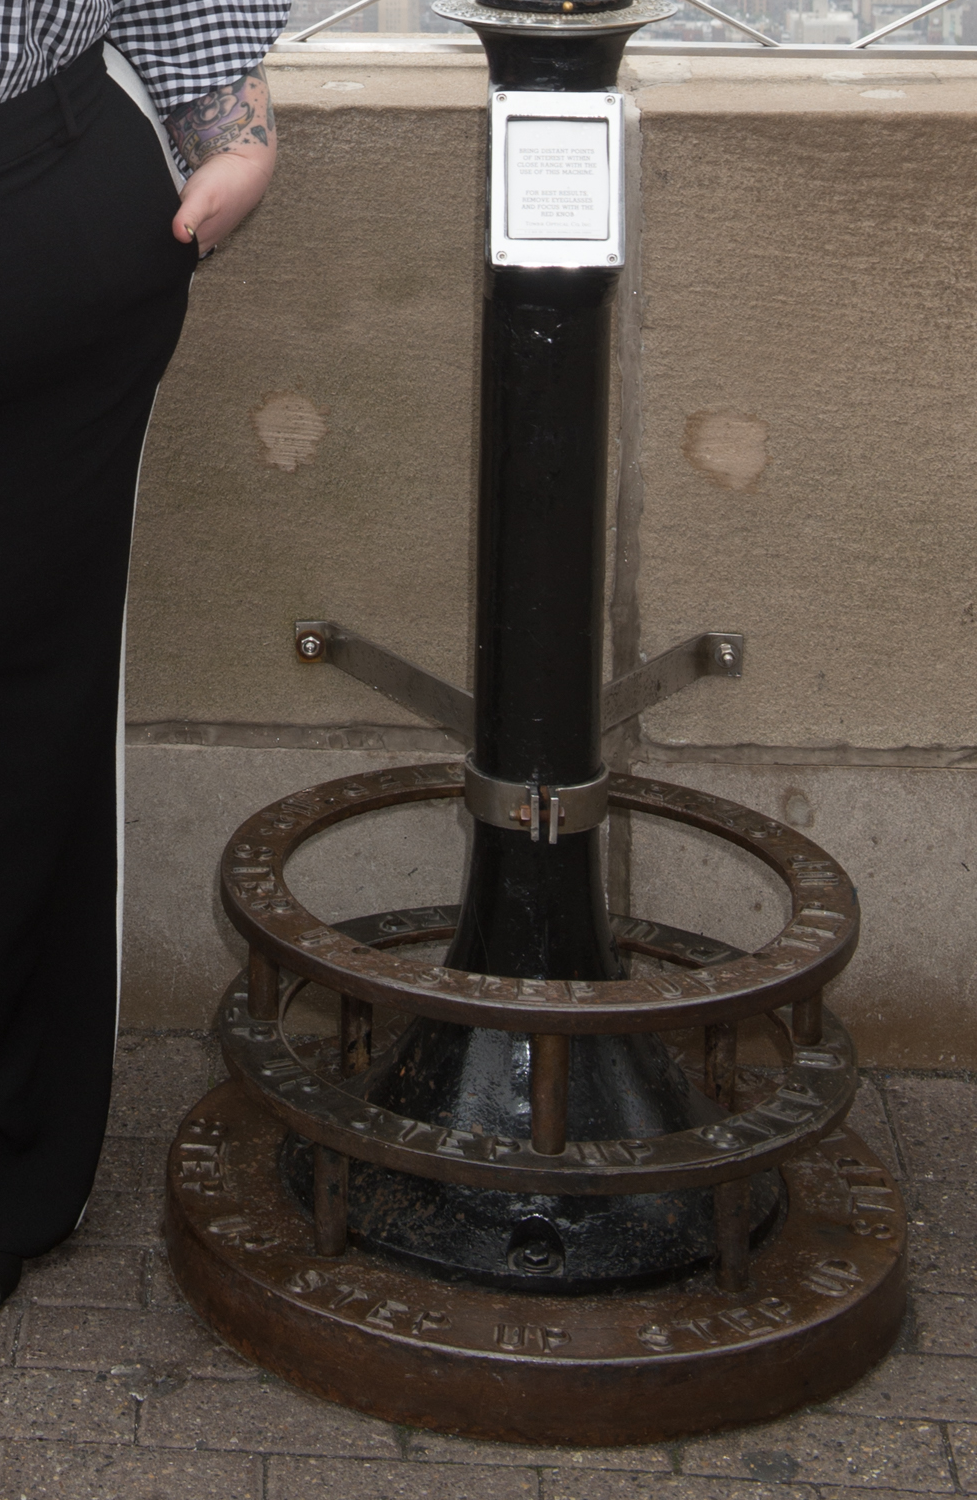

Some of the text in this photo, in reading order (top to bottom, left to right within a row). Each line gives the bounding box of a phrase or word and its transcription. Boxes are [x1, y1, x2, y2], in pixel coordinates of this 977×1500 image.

[411, 965, 596, 1004] STEP
[350, 1107, 653, 1165] STEP UP
[701, 1082, 823, 1150] STEP
[282, 1269, 569, 1353] STEP UP
[636, 1258, 864, 1352] STEP UP
